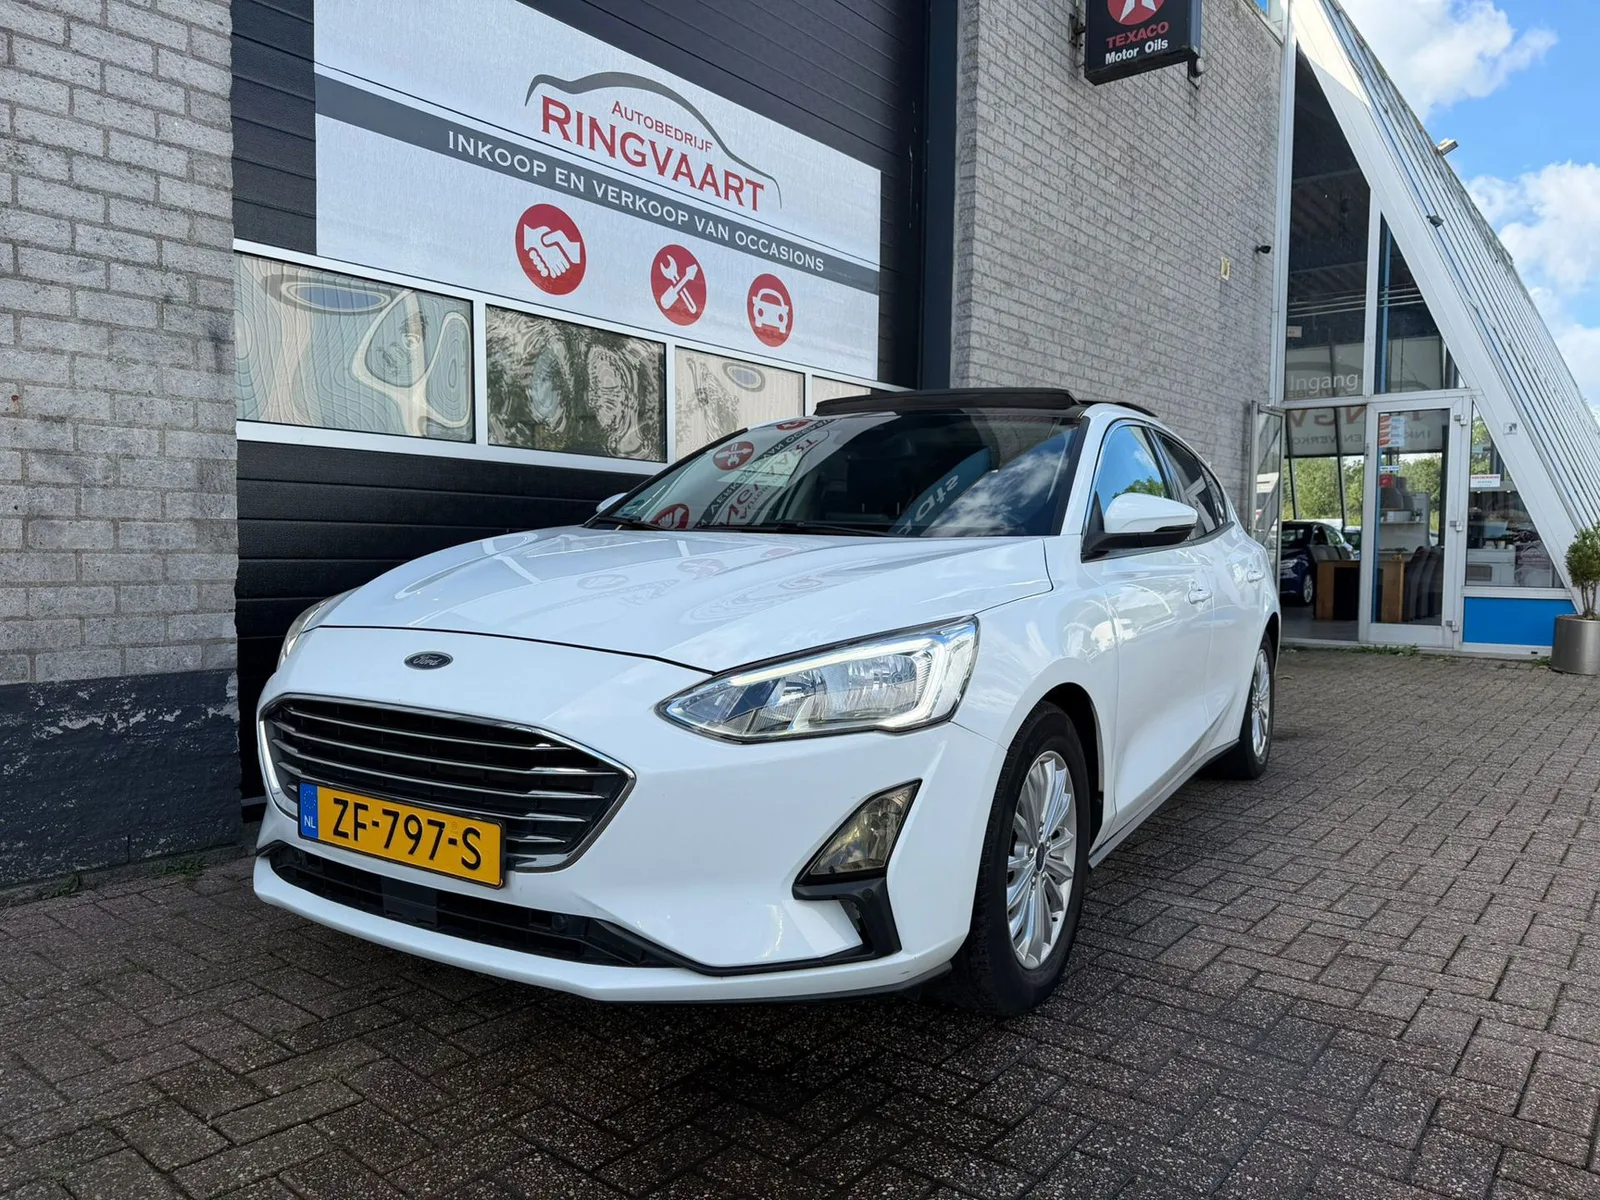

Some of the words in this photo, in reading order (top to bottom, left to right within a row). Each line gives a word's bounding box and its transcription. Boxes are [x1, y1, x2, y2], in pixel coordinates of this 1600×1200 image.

[1105, 46, 1140, 65] Motor
[1145, 38, 1168, 54] Oils
[1106, 21, 1169, 49] TEXACO
[611, 101, 714, 153] AUTOBEDRIJF
[541, 95, 765, 211] RINGVAART
[447, 131, 547, 177] INKOOP
[555, 169, 585, 193] EN
[593, 180, 689, 225] VERKOOP
[695, 216, 729, 241] VAN
[735, 230, 824, 272] OCCASIONS
[1290, 373, 1358, 394] Ingang
[304, 815, 316, 829] NL
[332, 797, 482, 871] ZF-797-S
